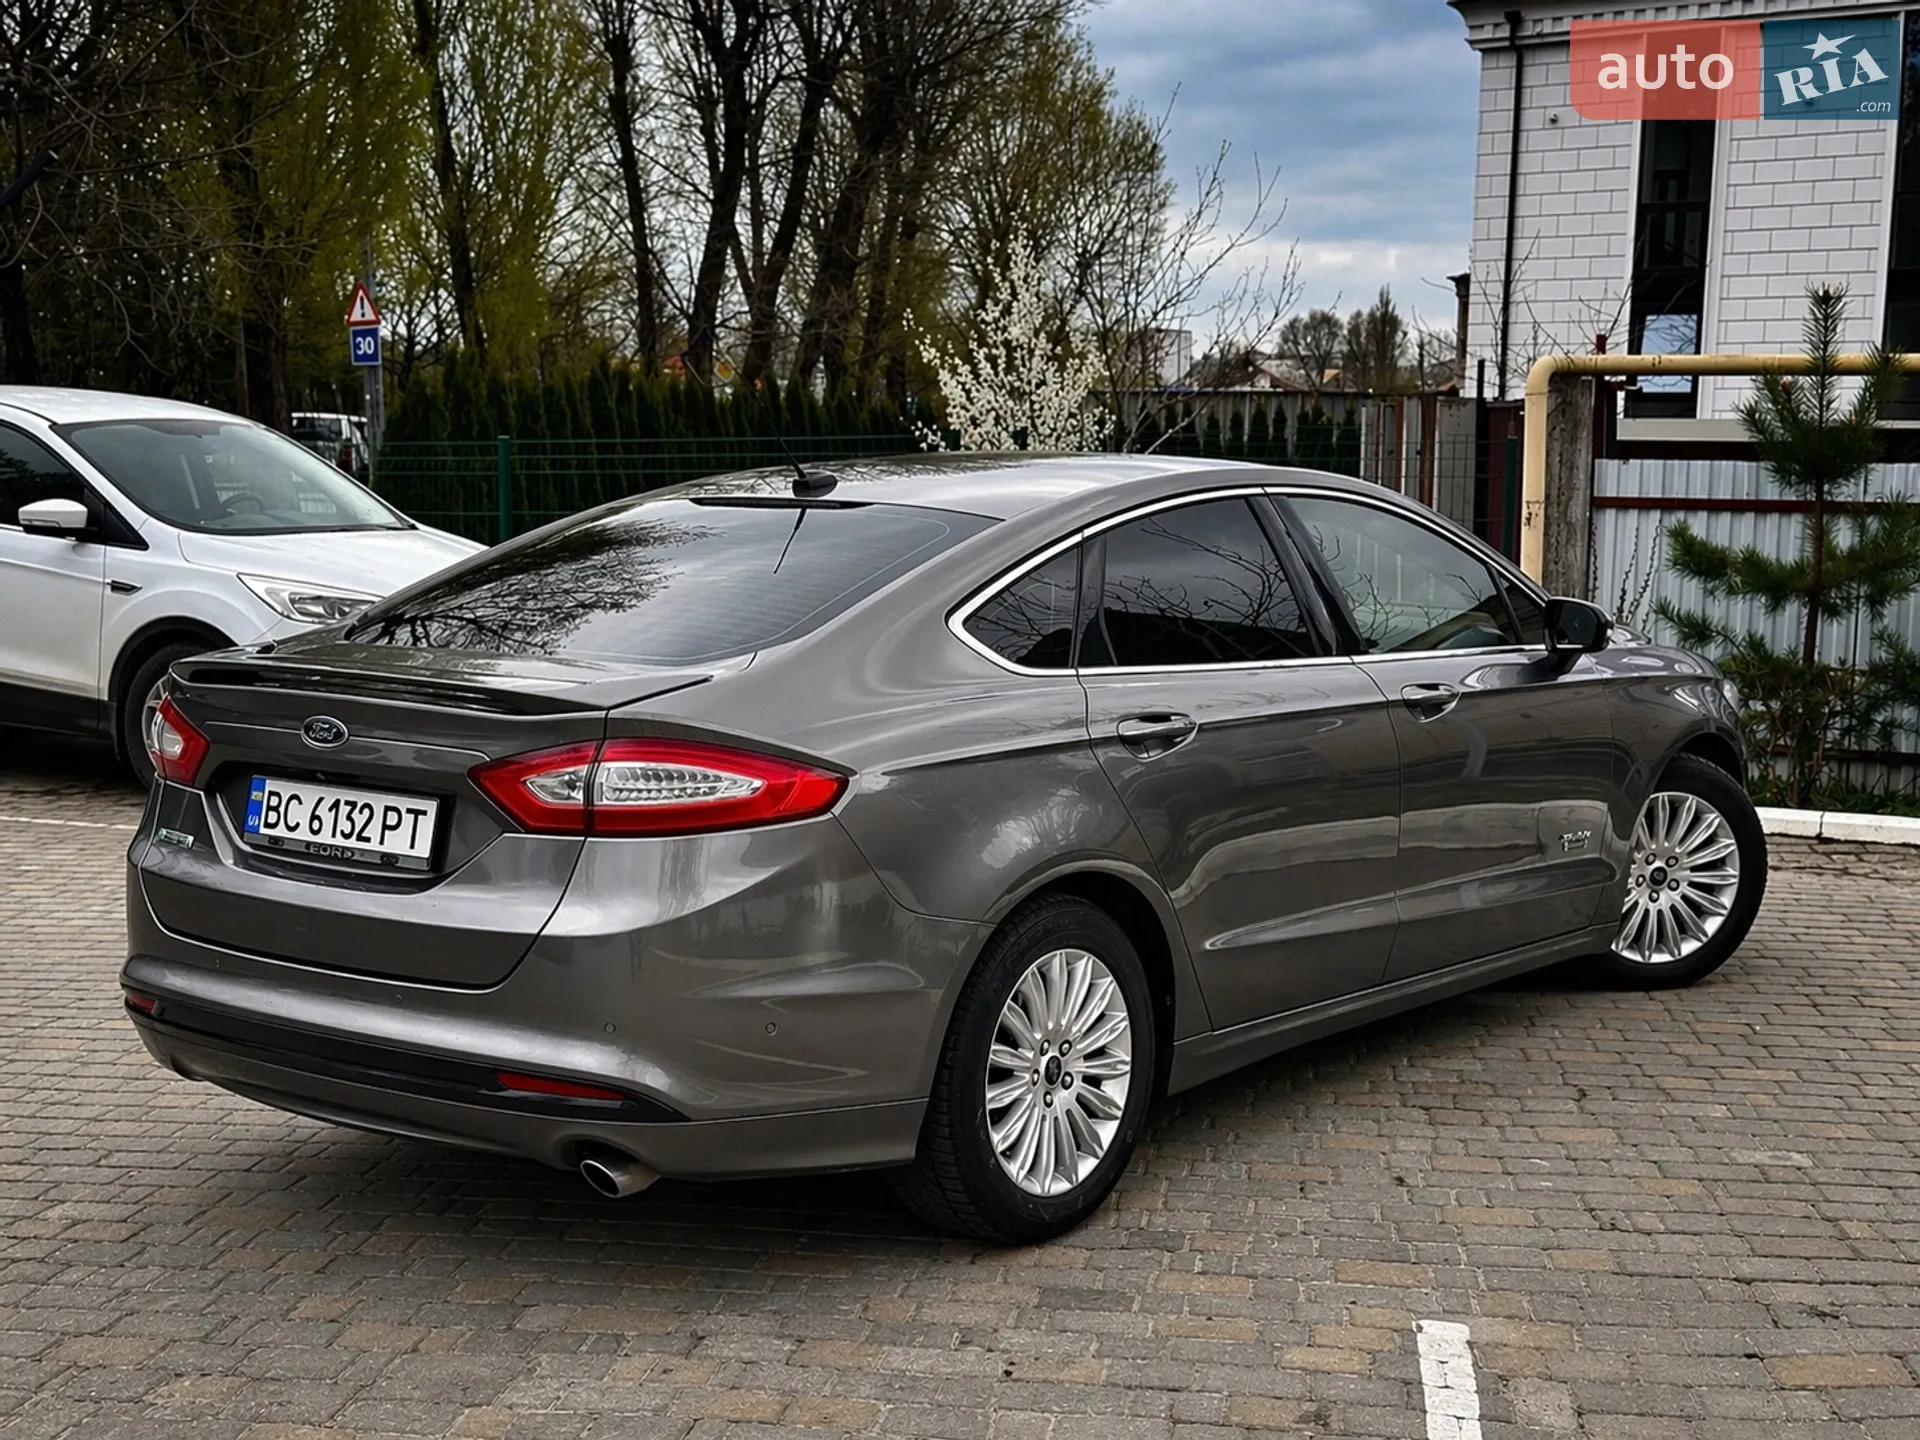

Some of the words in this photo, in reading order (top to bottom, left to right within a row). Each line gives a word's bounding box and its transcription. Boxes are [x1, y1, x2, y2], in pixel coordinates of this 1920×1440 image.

[356, 337, 374, 355] 30
[309, 722, 337, 740] Ford
[263, 790, 303, 832] BC
[308, 797, 375, 843] 6132
[379, 805, 428, 850] PT
